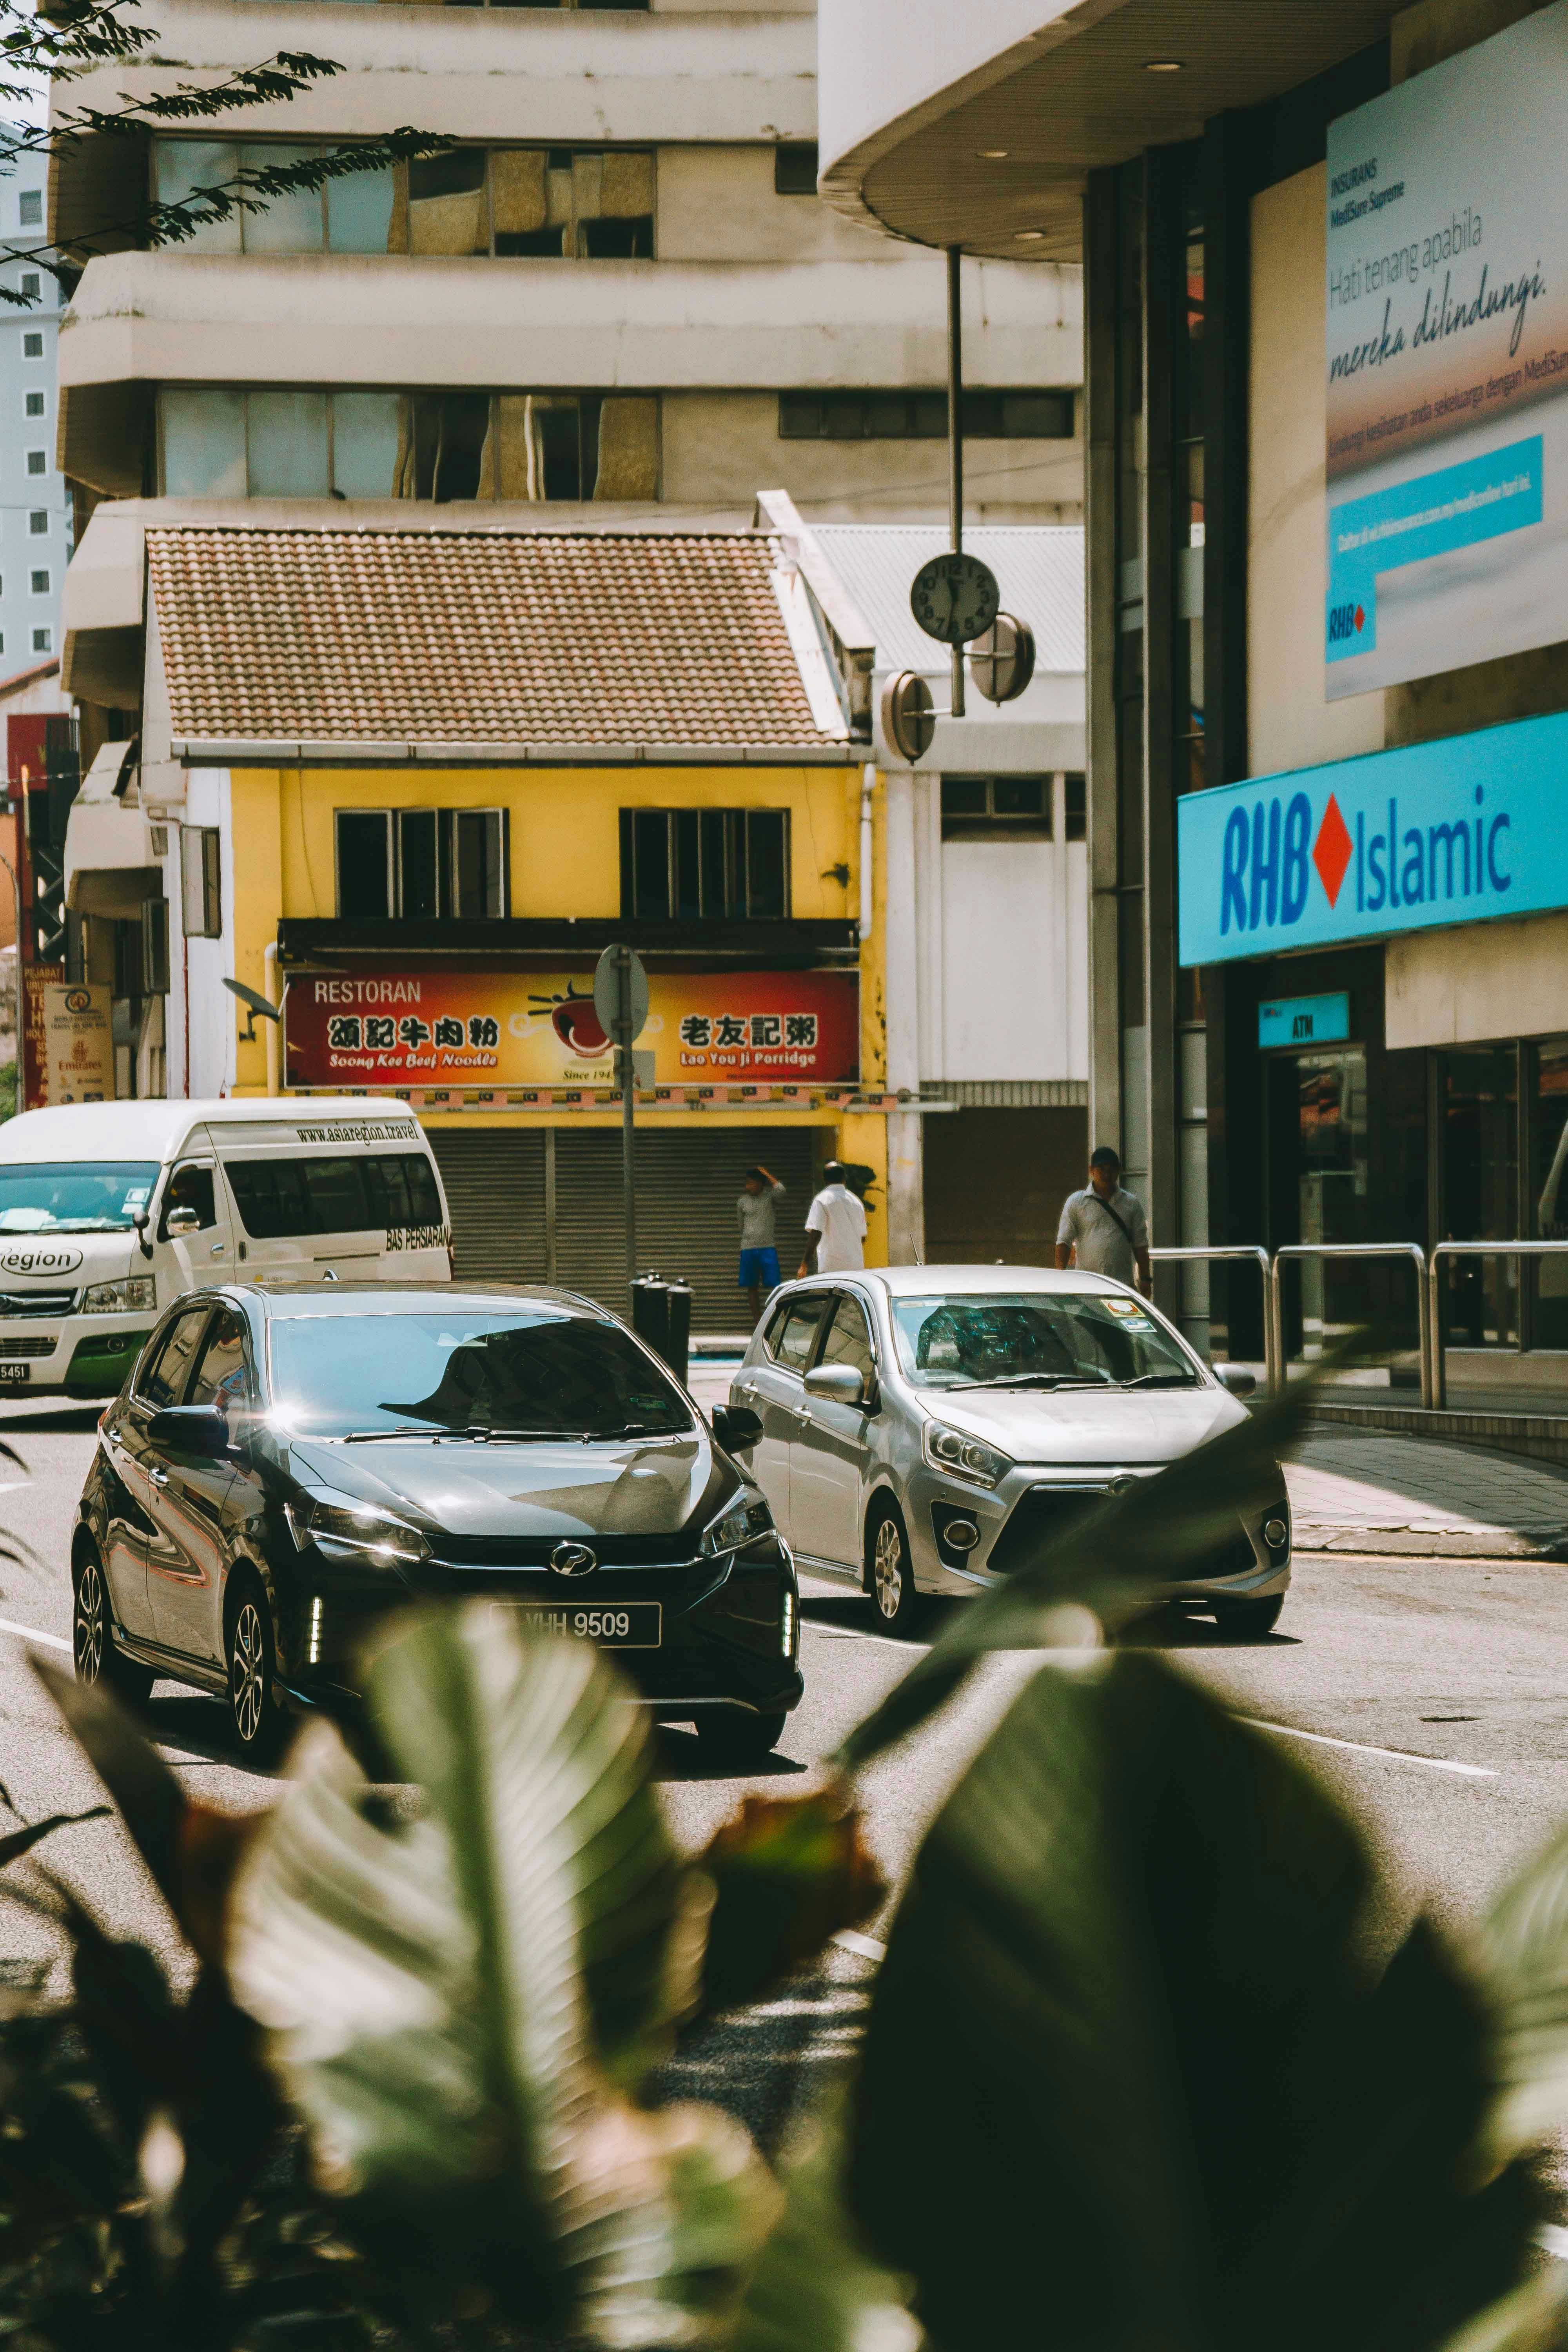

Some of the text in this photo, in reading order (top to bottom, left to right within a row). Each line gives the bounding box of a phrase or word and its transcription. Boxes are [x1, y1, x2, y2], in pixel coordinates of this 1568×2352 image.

[1369, 181, 1405, 212] Supreme
[1330, 206, 1482, 309] Hati tenang apabila
[1329, 297, 1406, 383] mereka
[1329, 603, 1354, 643] RHB
[1220, 785, 1512, 936] RHB Islamic
[315, 980, 421, 1004] RESTORAN
[679, 1014, 818, 1050] 老友記粥
[1292, 1014, 1313, 1039] ATM
[329, 1053, 497, 1070] Soong Kee Beef Noodle
[681, 1051, 706, 1066] Lao
[710, 1051, 735, 1066] You
[755, 1051, 817, 1068] Porridge
[563, 1069, 614, 1080] Since 194
[297, 1119, 419, 1146] www.asiaregion.travel
[386, 1225, 450, 1252] BAS PERSIARAN
[1, 1365, 24, 1378] 5451
[574, 1613, 629, 1637] 9509
